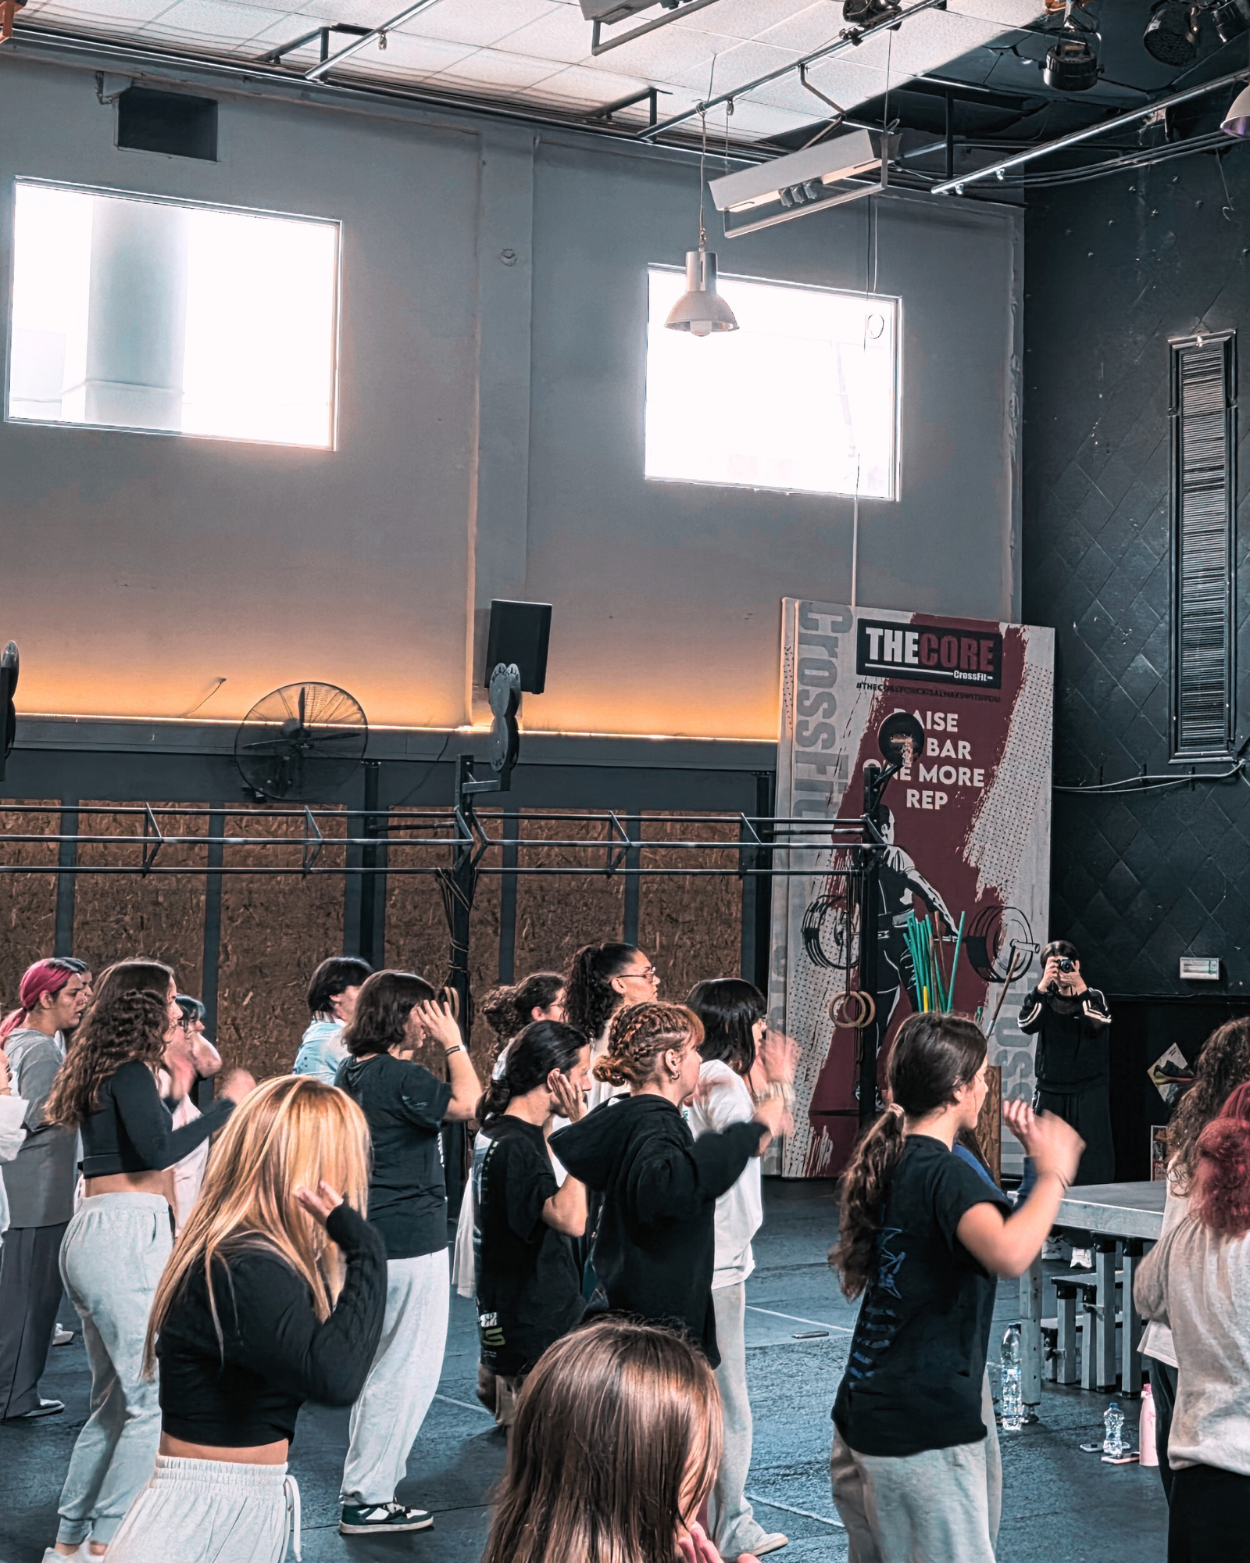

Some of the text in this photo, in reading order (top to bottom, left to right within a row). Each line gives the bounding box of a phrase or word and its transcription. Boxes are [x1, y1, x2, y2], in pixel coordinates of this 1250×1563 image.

[953, 669, 987, 683] CrossFit
[893, 708, 959, 733] AISE
[926, 737, 972, 760] BAR
[918, 763, 985, 788] MORE
[906, 788, 948, 811] REP
